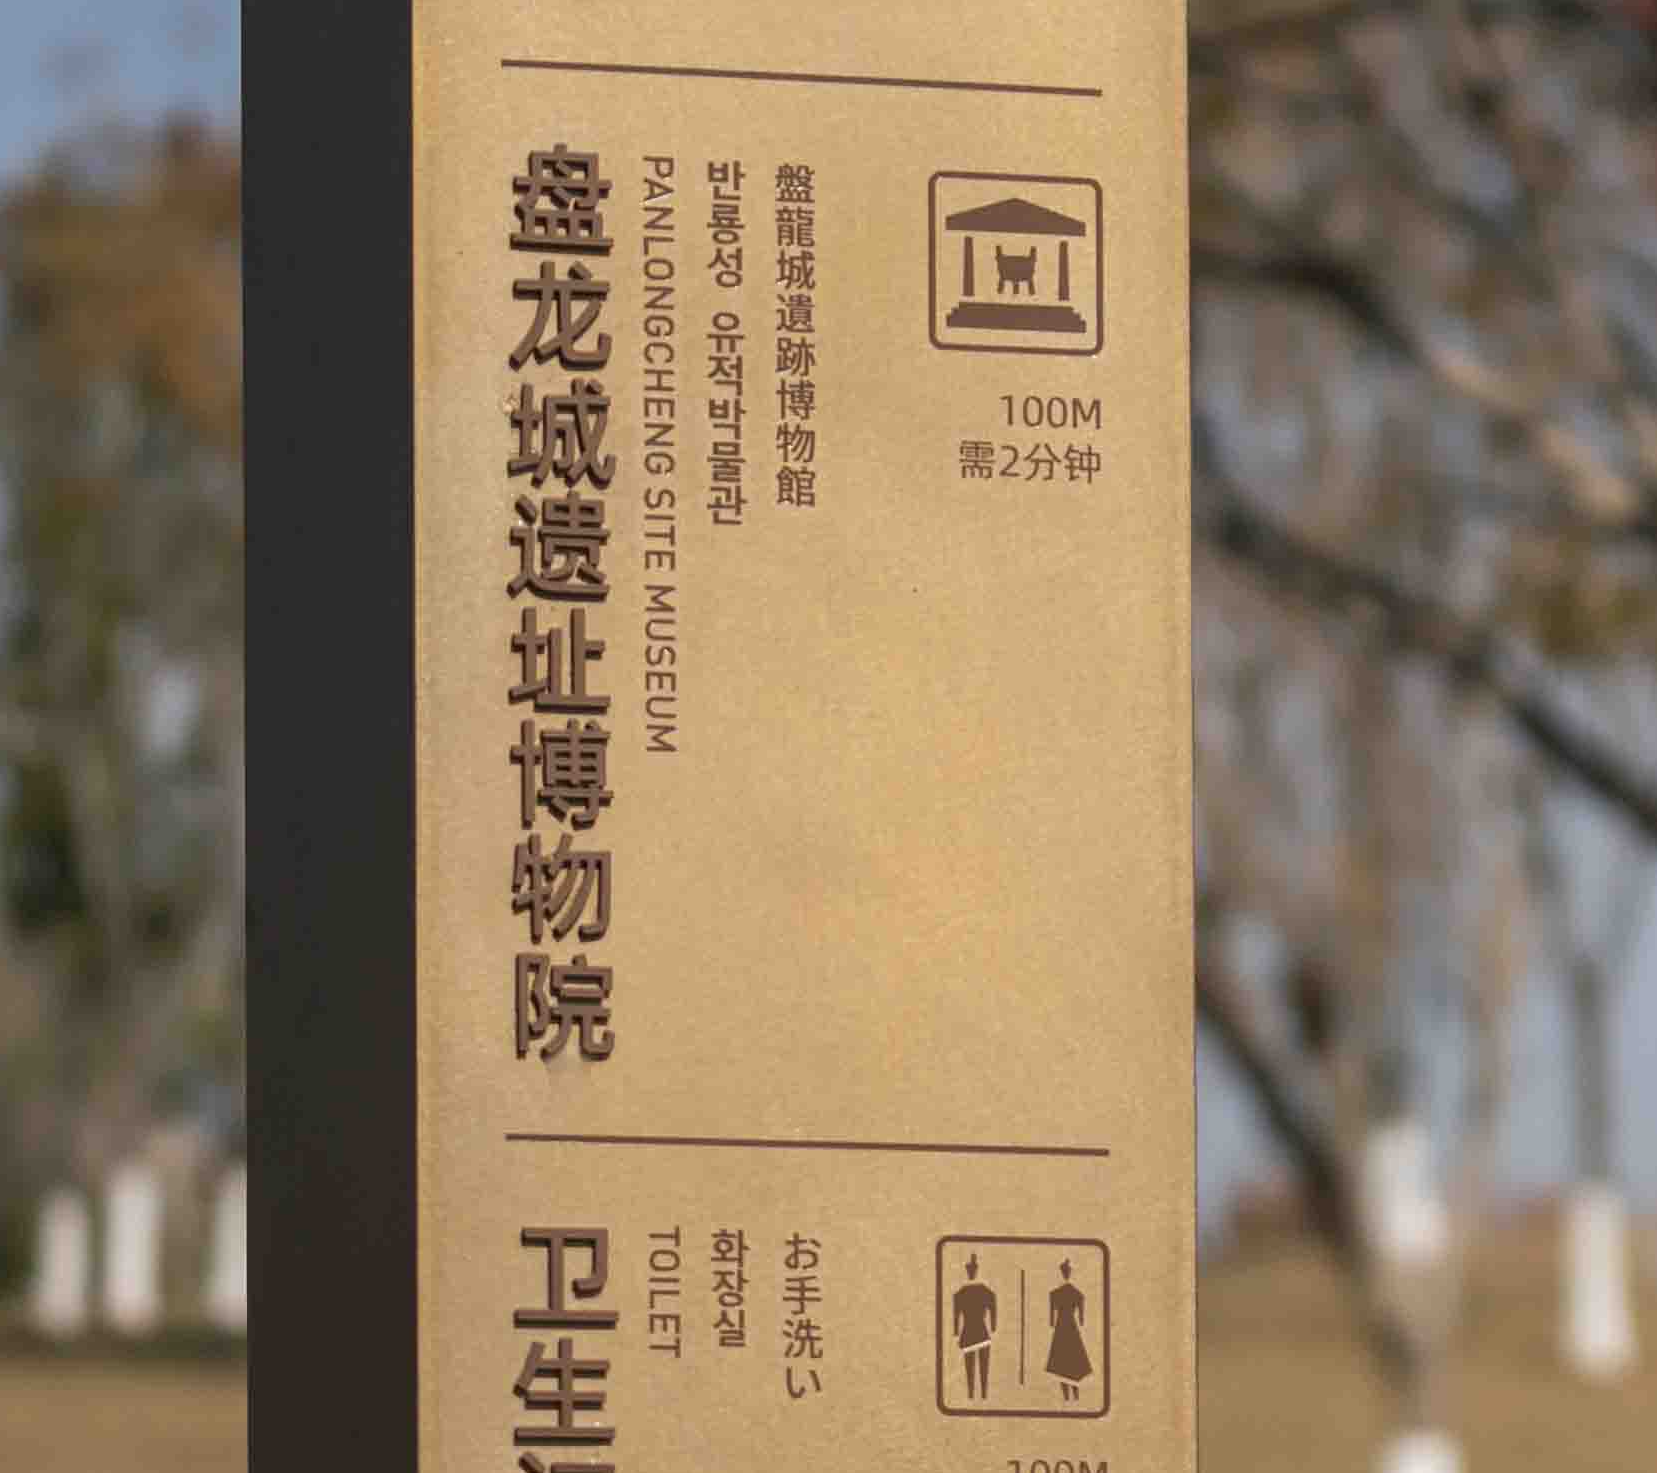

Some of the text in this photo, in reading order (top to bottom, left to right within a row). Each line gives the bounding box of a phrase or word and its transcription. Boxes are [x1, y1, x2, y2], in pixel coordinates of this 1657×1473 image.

[706, 160, 749, 526] 반룡성 유적박물관
[775, 163, 817, 507] 盤龍城遺跡博物館
[999, 395, 1101, 430] 100M
[642, 155, 679, 752] PANLONGCHENG SITE MUSEUM
[959, 440, 1101, 484] 需2分钟
[505, 143, 617, 1066] 盘龙城遗址博物院
[648, 1225, 681, 1358] TOILET
[711, 1229, 751, 1347] 화장실
[783, 1232, 823, 1400] お手洗い
